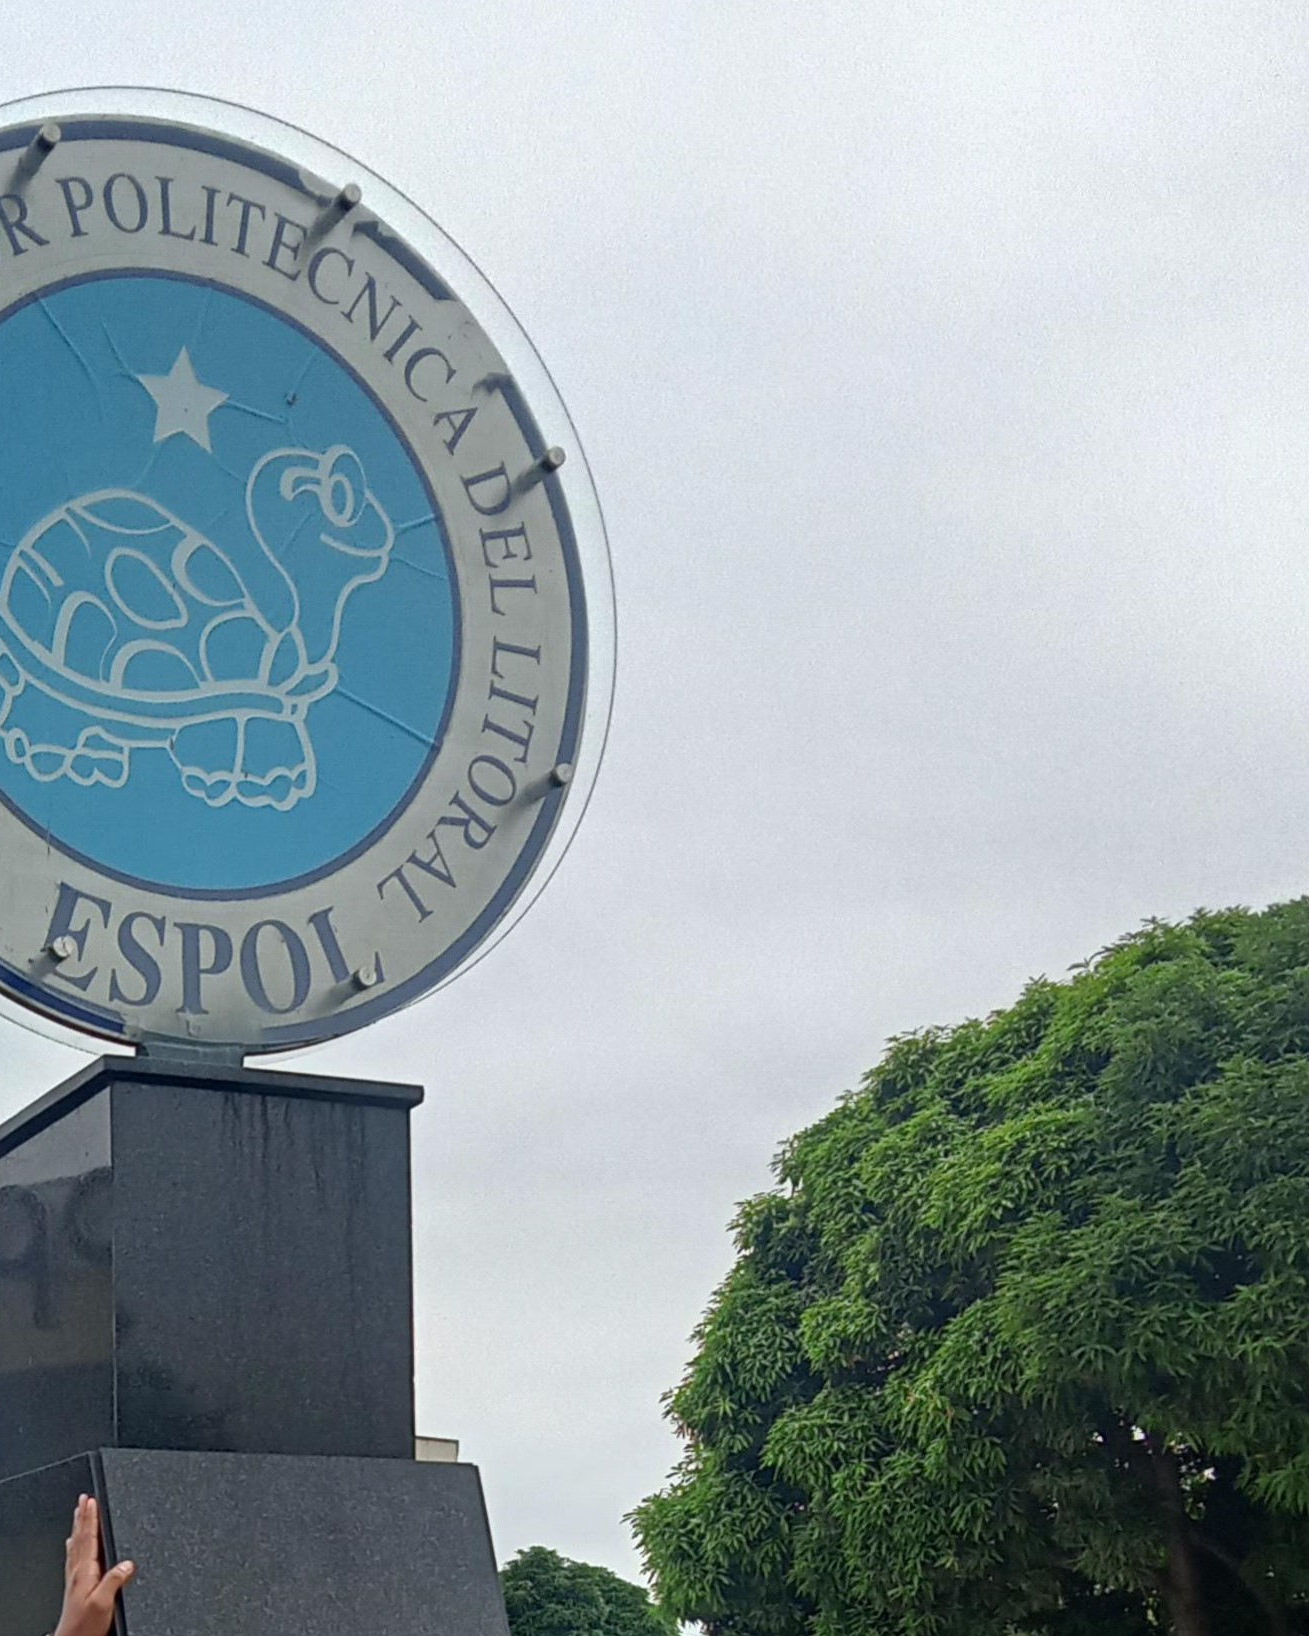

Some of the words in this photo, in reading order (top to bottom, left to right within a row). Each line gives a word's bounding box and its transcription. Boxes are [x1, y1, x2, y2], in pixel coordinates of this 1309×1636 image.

[55, 172, 479, 457] POLITECNICA
[459, 459, 539, 617] DEL
[376, 634, 542, 924] LITORAL
[28, 880, 386, 1016] ESPOL
